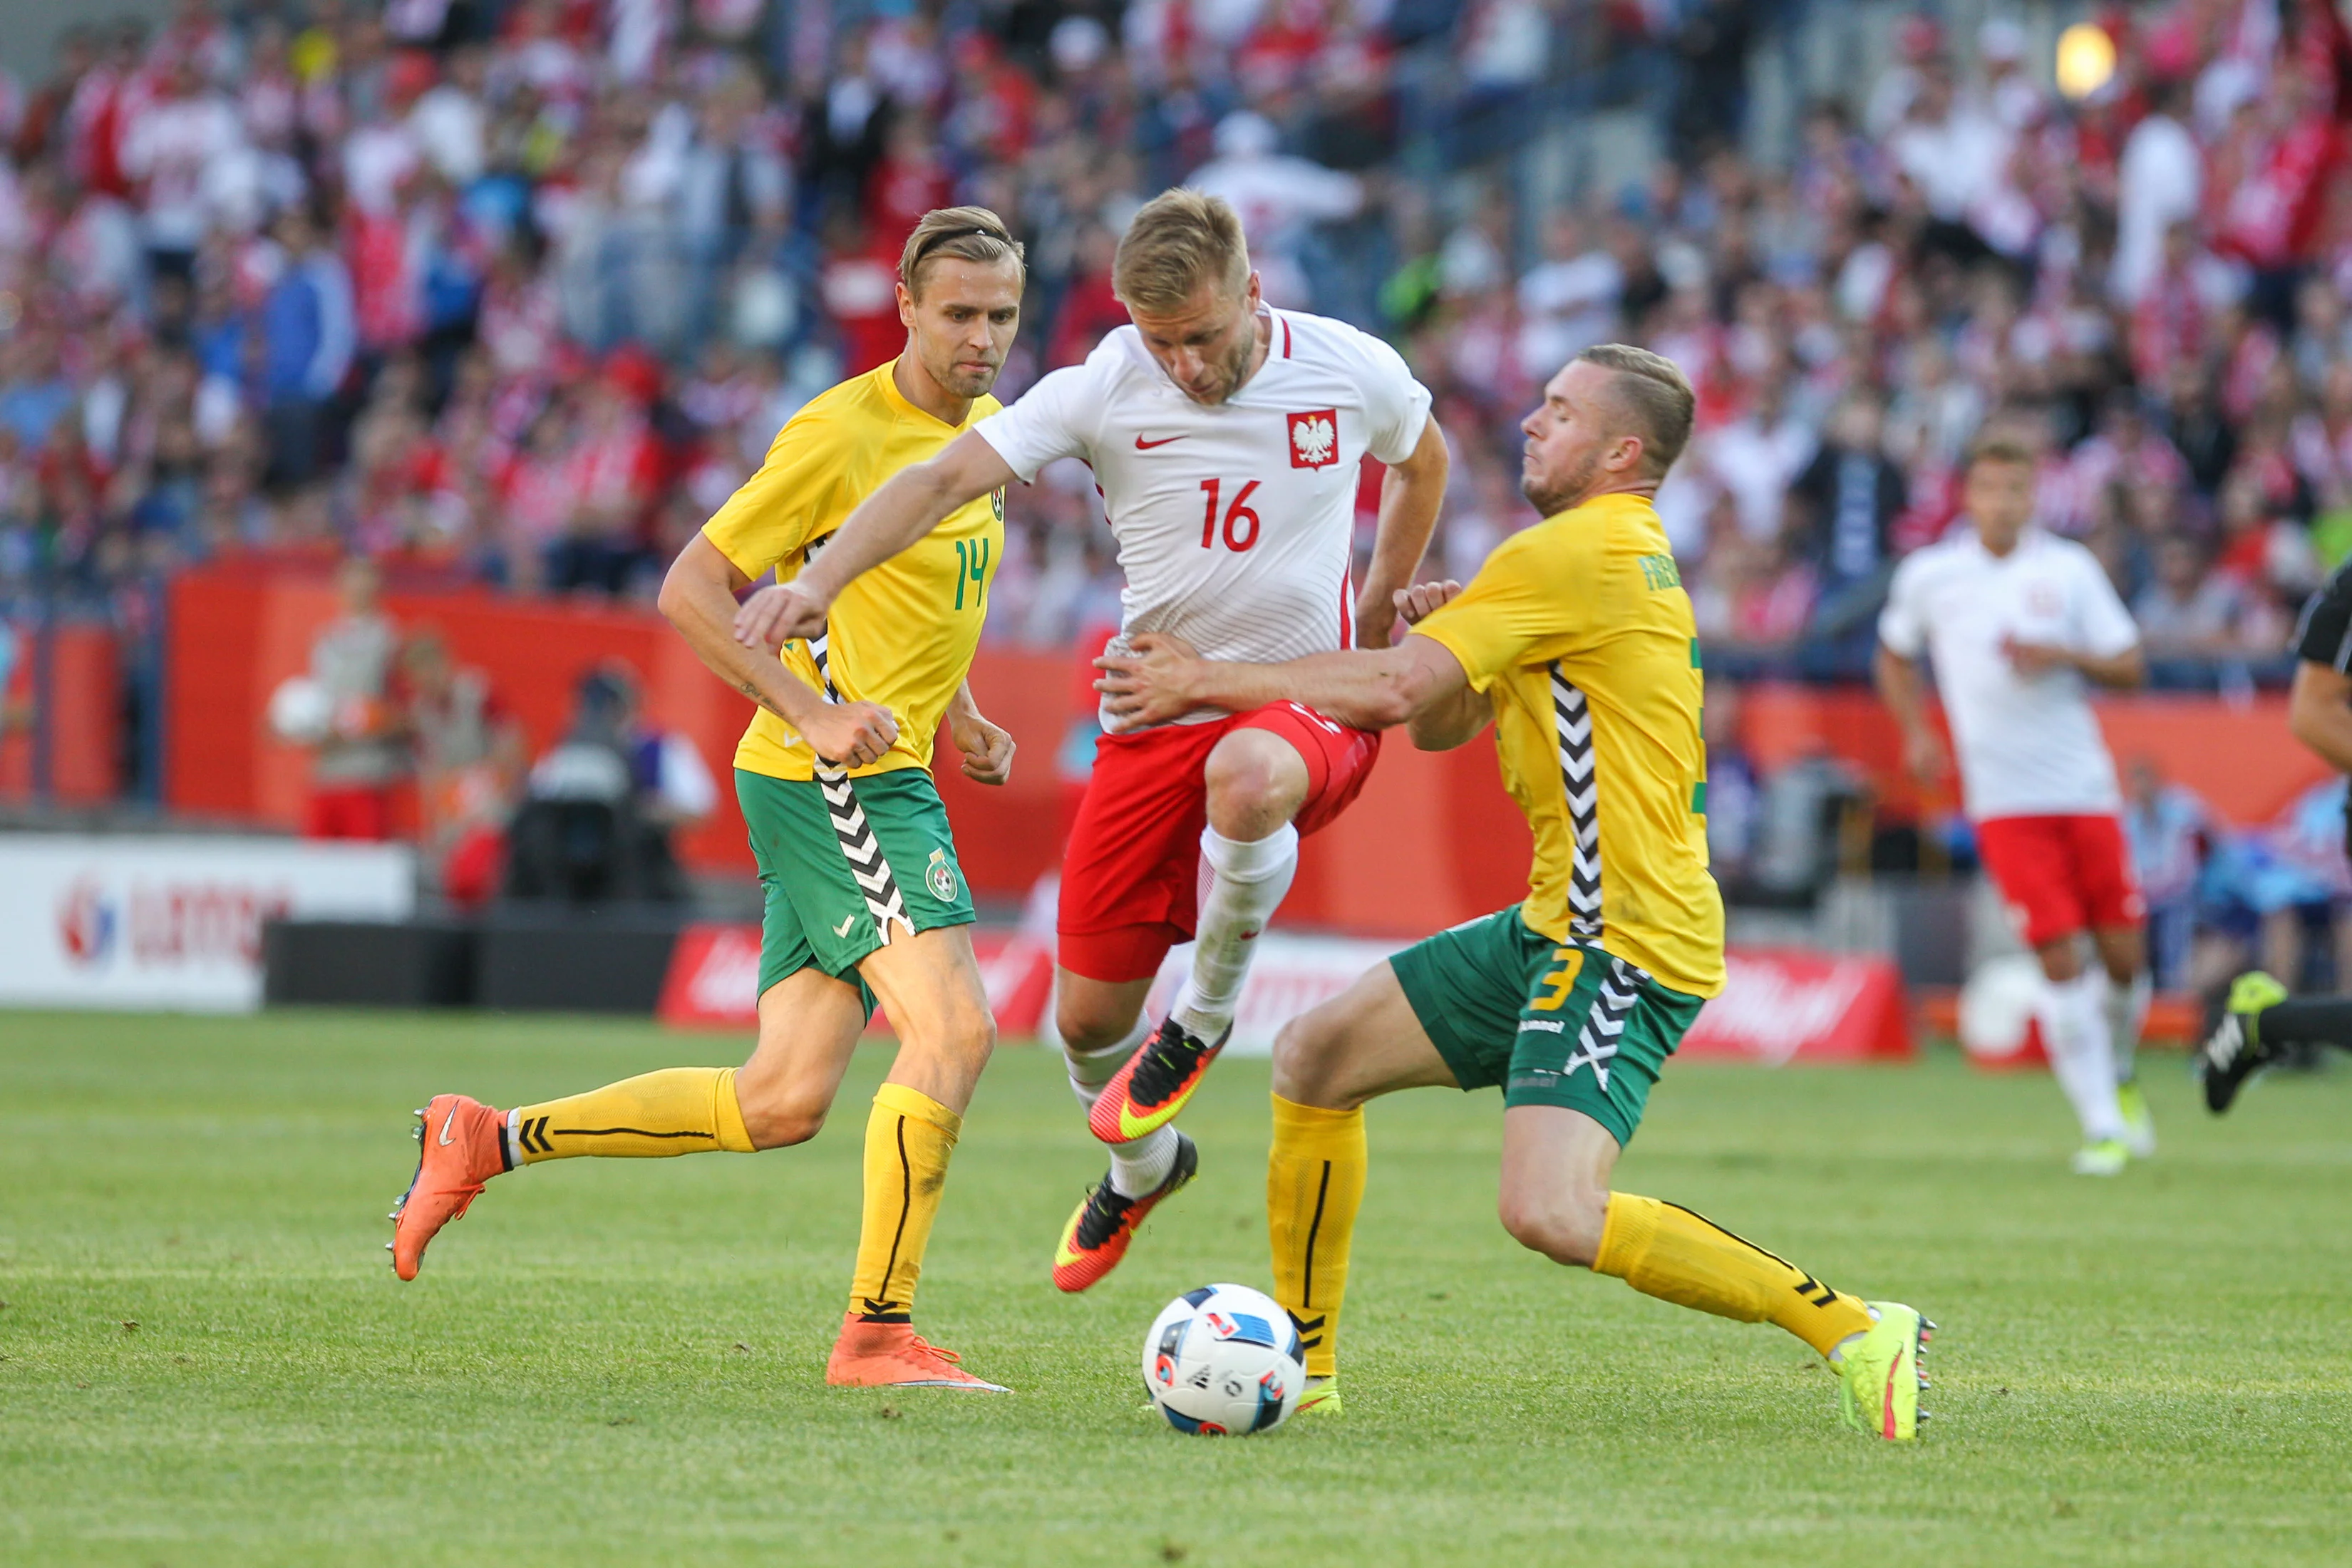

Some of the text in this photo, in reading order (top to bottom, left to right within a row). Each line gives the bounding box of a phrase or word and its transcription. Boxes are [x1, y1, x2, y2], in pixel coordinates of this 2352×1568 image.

[1200, 478, 1262, 552] 16
[955, 537, 989, 610] 14
[1529, 948, 1584, 1011] 3
